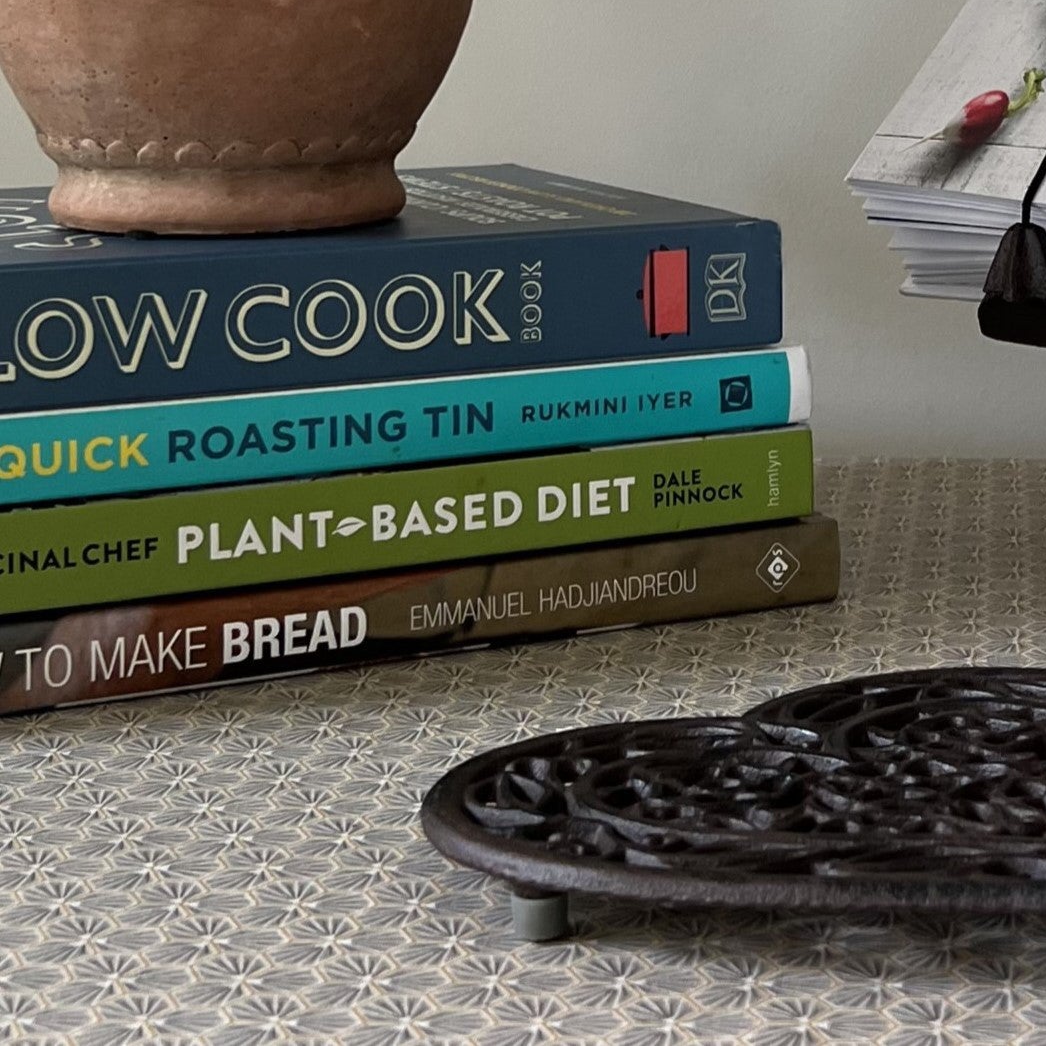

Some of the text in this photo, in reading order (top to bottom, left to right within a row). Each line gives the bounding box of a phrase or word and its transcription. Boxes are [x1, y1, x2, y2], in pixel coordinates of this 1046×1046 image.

[519, 260, 543, 343] BOOK
[708, 259, 741, 317] DK
[0, 268, 511, 382] OW COOK
[521, 390, 692, 424] RUKMINI IYER
[0, 401, 494, 480] QUICK ROASTING TIN
[537, 476, 636, 522] DIET
[653, 469, 701, 489] DALE
[653, 483, 743, 508] PINNOCK
[767, 449, 782, 507] hamlyn
[82, 537, 158, 566] CHEF
[410, 570, 698, 632] EMMANUEL HADJIANDREOU
[15, 606, 367, 692] TO MAKE BREAD
